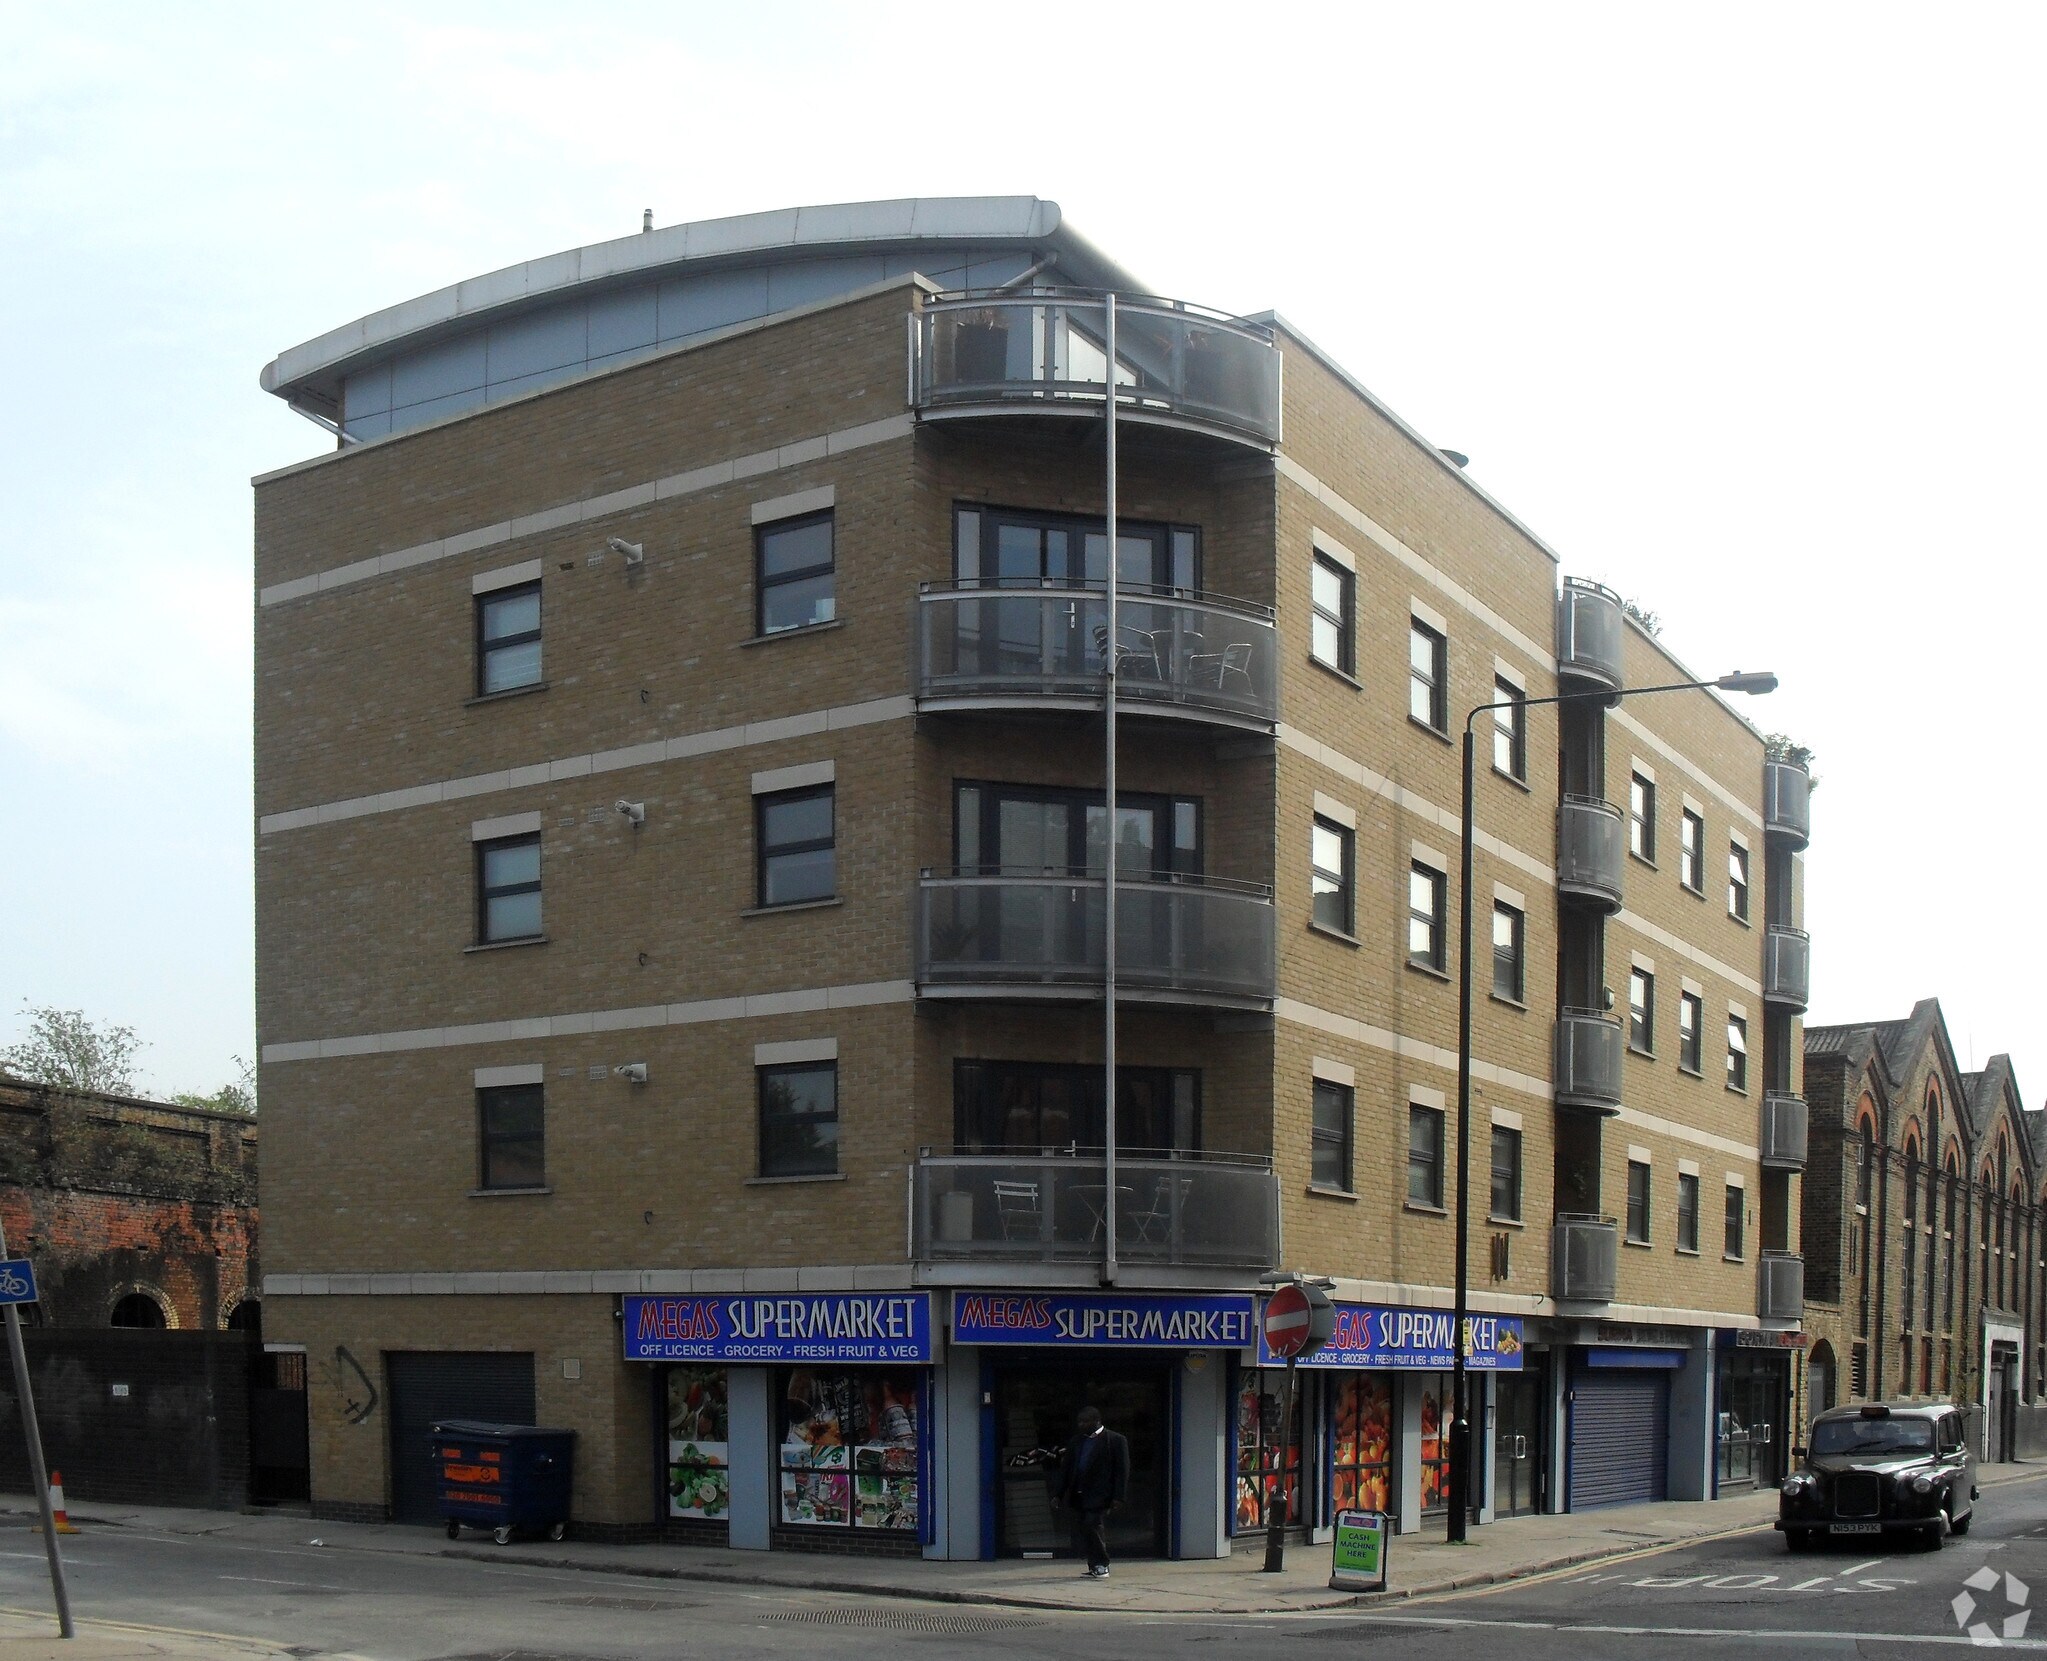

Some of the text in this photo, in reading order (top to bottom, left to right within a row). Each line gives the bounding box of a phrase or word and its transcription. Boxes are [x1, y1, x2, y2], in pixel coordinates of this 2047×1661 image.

[637, 1298, 916, 1340] MEGAS SUPERMARKET
[960, 1296, 1249, 1340] MEGAS SUPERMARKET
[1325, 1311, 1371, 1351] GAS
[640, 1344, 662, 1356] OFF
[665, 1344, 715, 1356] LICENCE
[724, 1345, 783, 1357] GROCERY
[794, 1345, 835, 1358] FRESH
[838, 1345, 875, 1358] FRUIT
[878, 1346, 888, 1357] &
[891, 1345, 919, 1357] VEG
[1311, 1352, 1337, 1364] LICENCE
[1341, 1353, 1370, 1365] GROCERY
[1374, 1354, 1393, 1365] FRESH
[1394, 1354, 1410, 1365] FRUIT
[1415, 1355, 1427, 1365] VEG
[1430, 1355, 1446, 1366] NEWS
[1469, 1356, 1496, 1366] MAGAZINES
[1348, 1532, 1370, 1541] CASH
[1340, 1541, 1376, 1551] MACHINE
[1346, 1549, 1367, 1558] HERE
